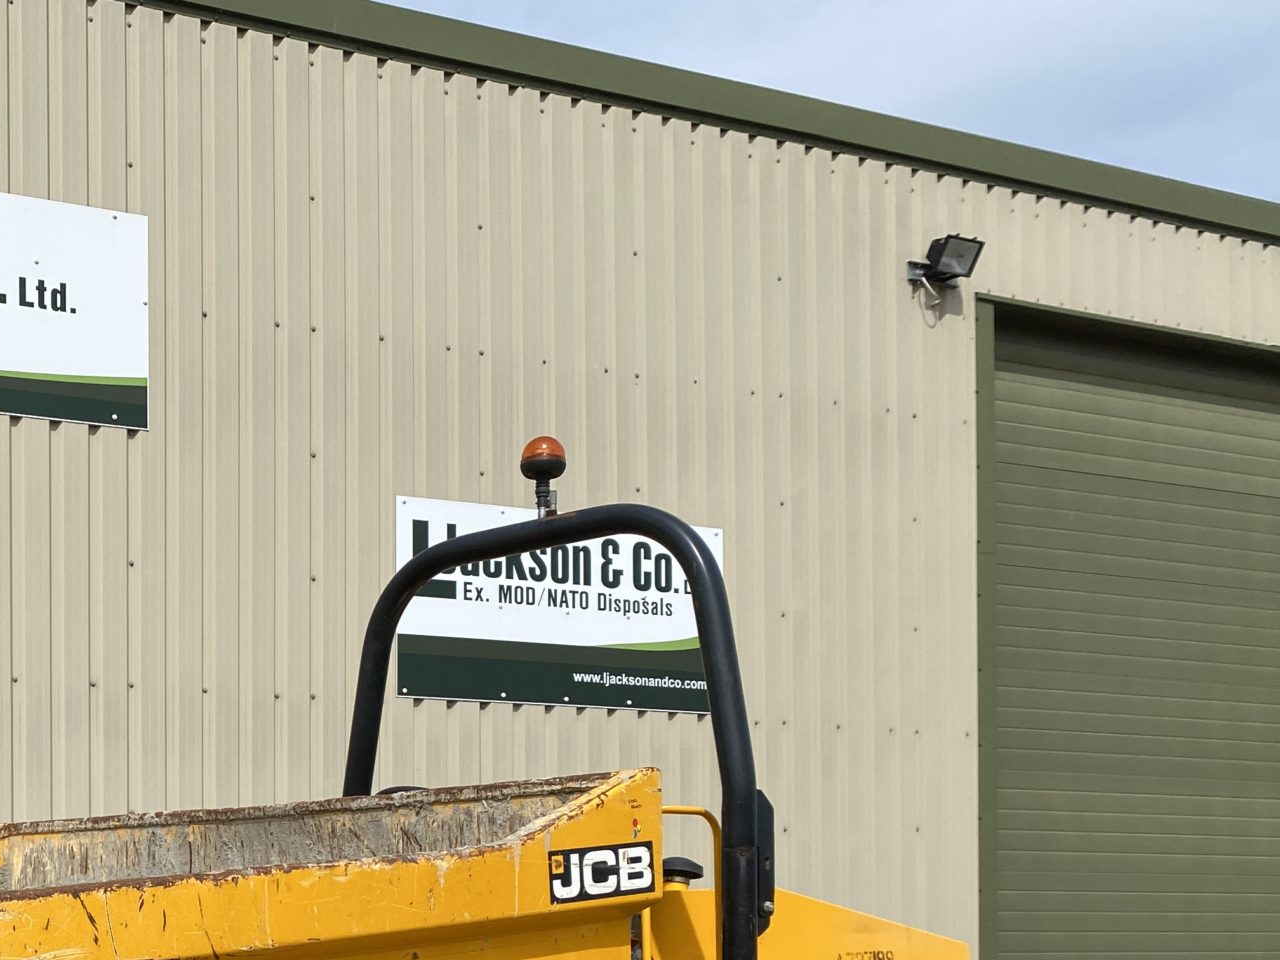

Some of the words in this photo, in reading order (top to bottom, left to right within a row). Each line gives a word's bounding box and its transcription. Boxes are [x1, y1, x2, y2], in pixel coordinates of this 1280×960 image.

[18, 276, 77, 314] Ltd.
[601, 538, 624, 589] &
[632, 541, 680, 594] Co.
[463, 581, 490, 602] Ex.
[498, 584, 589, 610] MOD/NATO
[597, 592, 673, 617] Disposals
[572, 672, 708, 690] www.ljacksonandco.com
[552, 845, 653, 899] JCB
